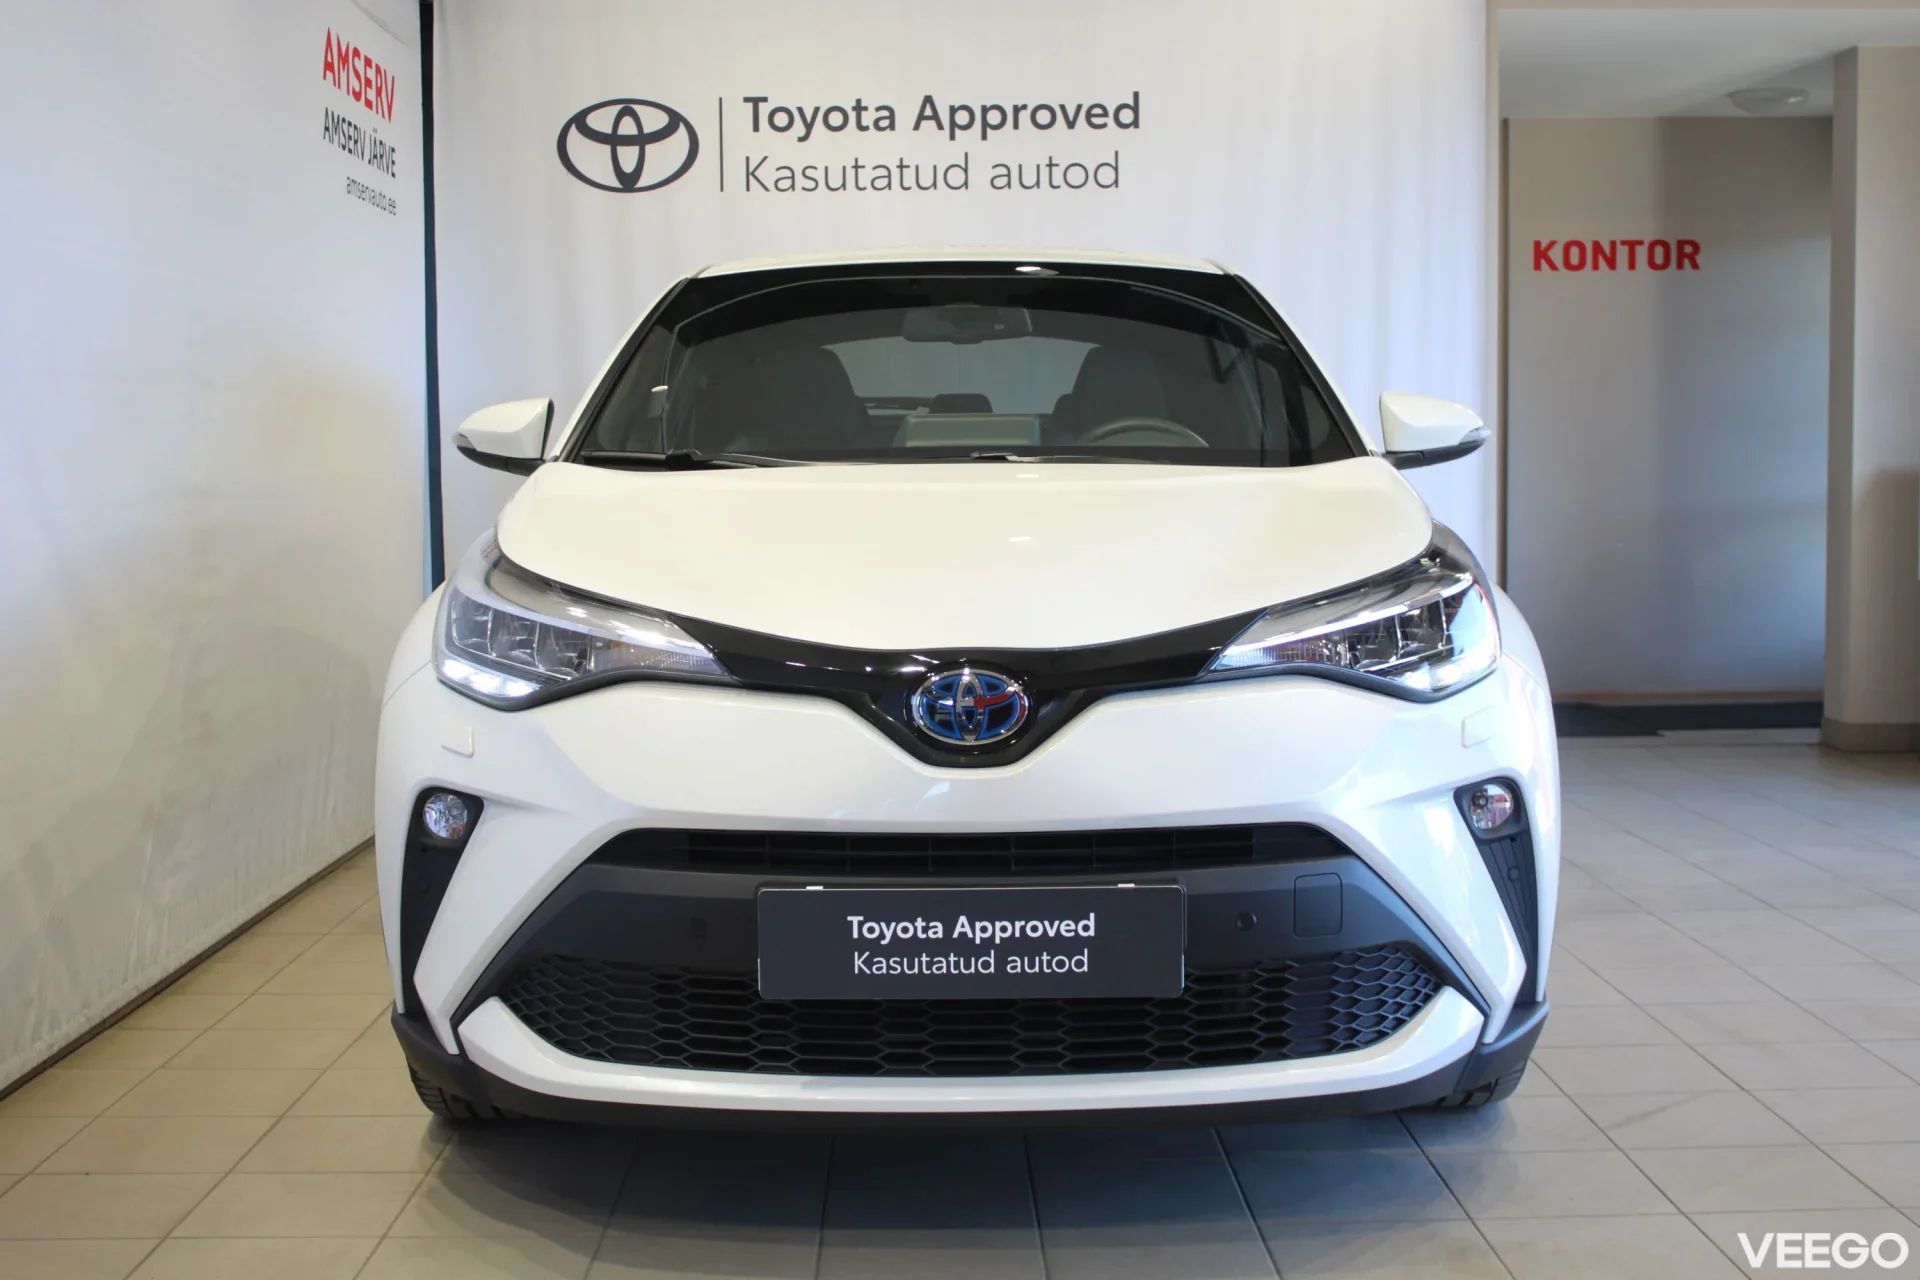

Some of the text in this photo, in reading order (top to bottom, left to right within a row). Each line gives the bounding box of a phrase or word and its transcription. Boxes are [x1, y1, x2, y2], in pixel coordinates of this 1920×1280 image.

[323, 26, 396, 124] AMSERV
[742, 90, 1142, 143] Toyota Approved
[323, 106, 396, 179] AMSERV JÄRVE
[744, 149, 1121, 193] Kasutatud autod
[346, 175, 397, 216] amservauto.ee
[1532, 239, 1701, 273] KONTOR
[846, 912, 1096, 946] Toyota Approved
[853, 947, 1089, 976] Kasutatud autod
